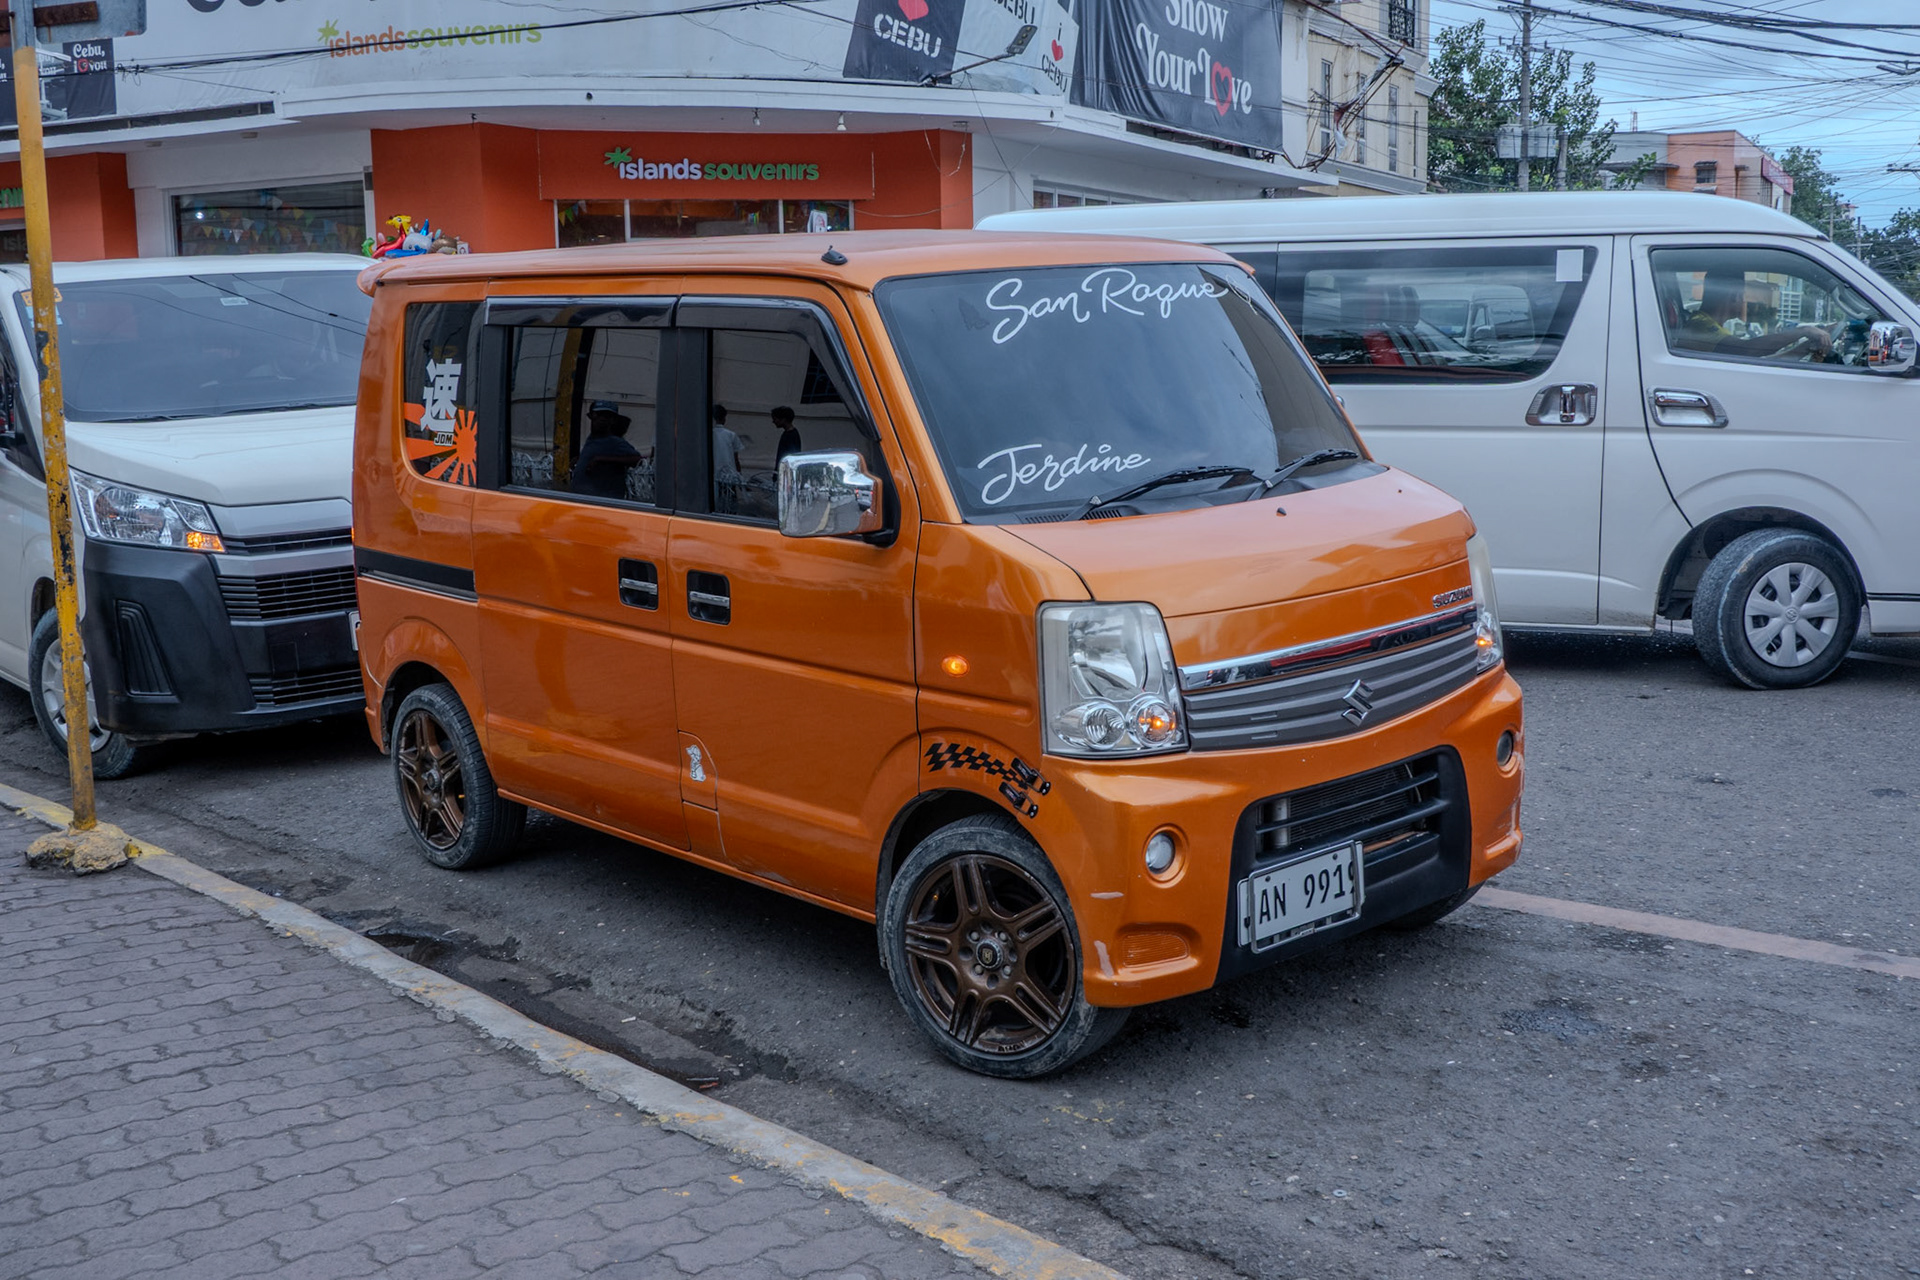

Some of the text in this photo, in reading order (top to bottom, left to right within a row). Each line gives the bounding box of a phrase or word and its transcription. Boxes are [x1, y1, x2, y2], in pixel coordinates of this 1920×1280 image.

[995, 0, 1035, 24] EBU
[73, 43, 106, 58] Cebu,
[329, 22, 542, 58] islands souvenirs
[874, 13, 942, 58] CEBU
[1042, 54, 1067, 92] CEBU
[1136, 22, 1196, 95] Your
[619, 157, 819, 180] islands souvenirs
[986, 268, 1229, 344] San Roque
[434, 433, 453, 445] JDM
[1432, 585, 1472, 609] SUZUK
[1244, 883, 1286, 929] AN
